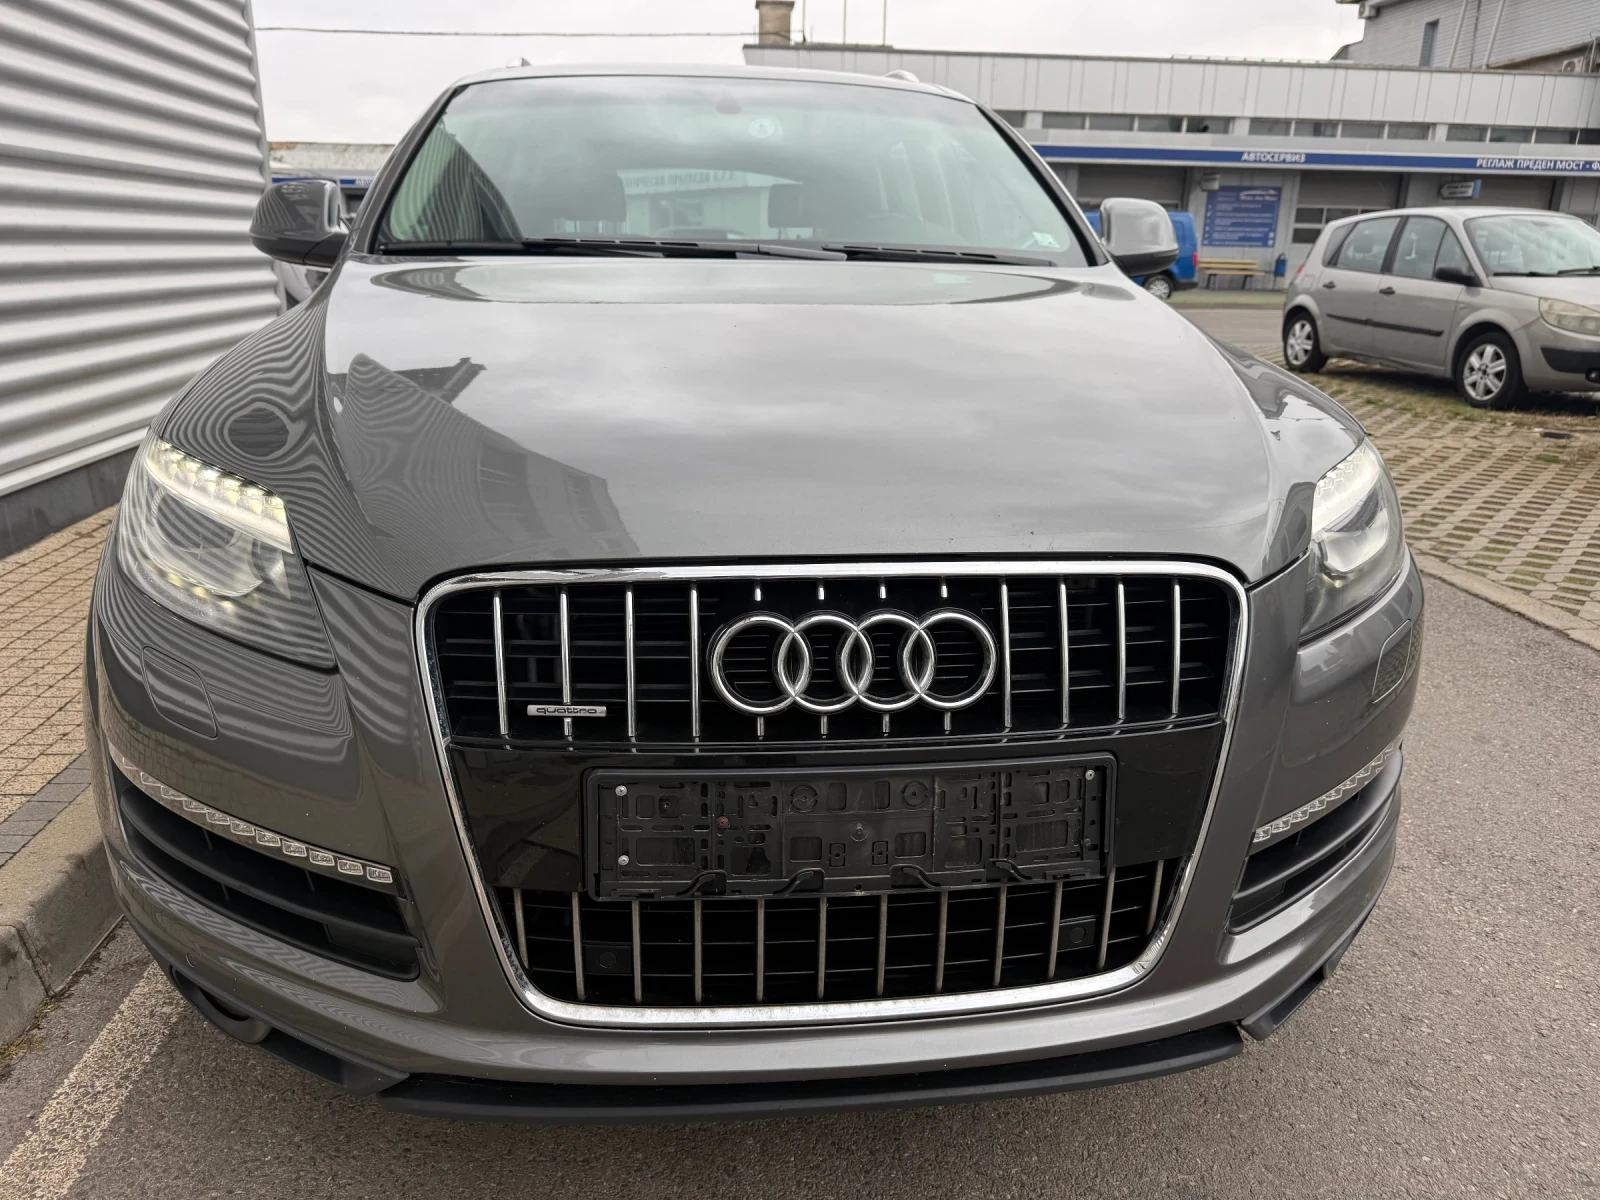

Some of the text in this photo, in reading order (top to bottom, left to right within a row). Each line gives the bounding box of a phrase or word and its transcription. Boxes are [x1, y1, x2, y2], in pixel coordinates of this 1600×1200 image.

[1242, 152, 1307, 163] АВТОСЕРВИЗ
[1476, 158, 1515, 169] РЕГЛАЖ
[1516, 159, 1555, 170] ПРЕДЕН
[1556, 160, 1585, 170] МОСТ
